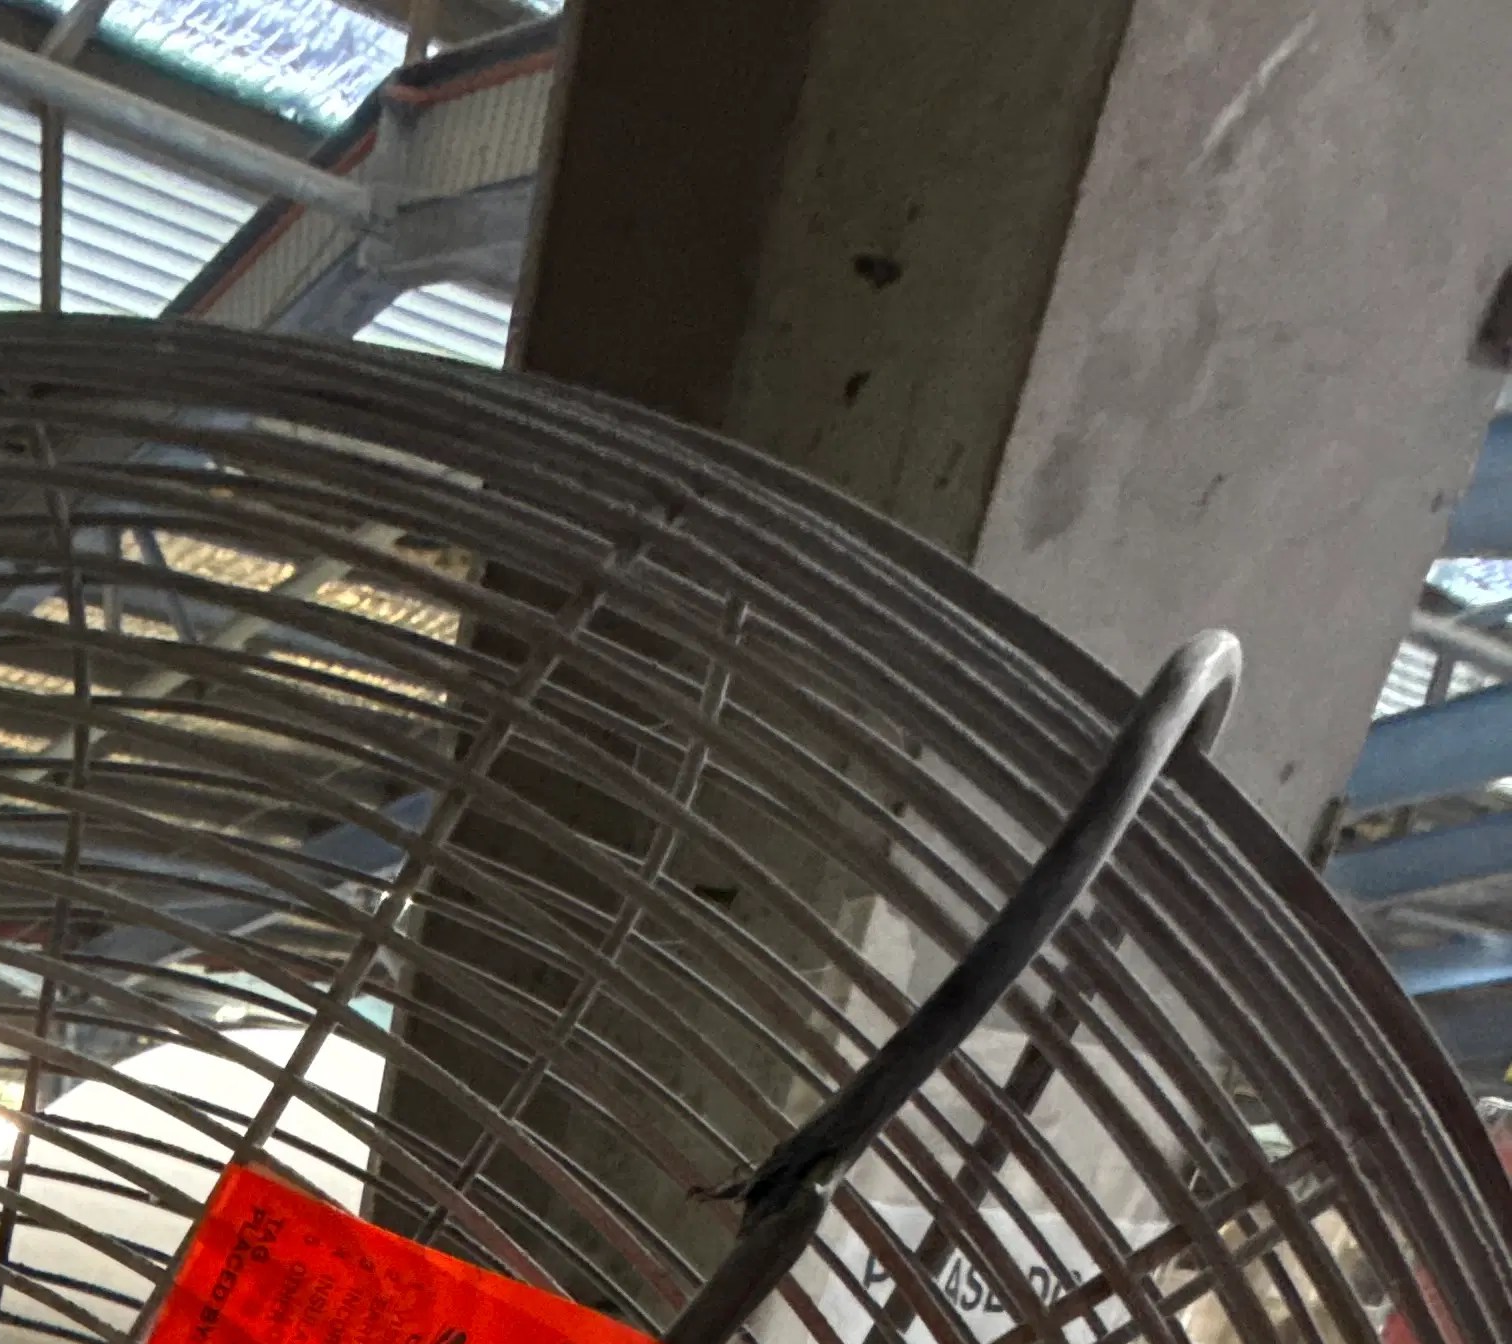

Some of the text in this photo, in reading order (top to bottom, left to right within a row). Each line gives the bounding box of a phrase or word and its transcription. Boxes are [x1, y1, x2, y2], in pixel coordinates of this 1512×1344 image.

[209, 1204, 268, 1304] PLACED
[247, 1213, 288, 1266] TAG
[864, 1252, 1010, 1313] PASE
